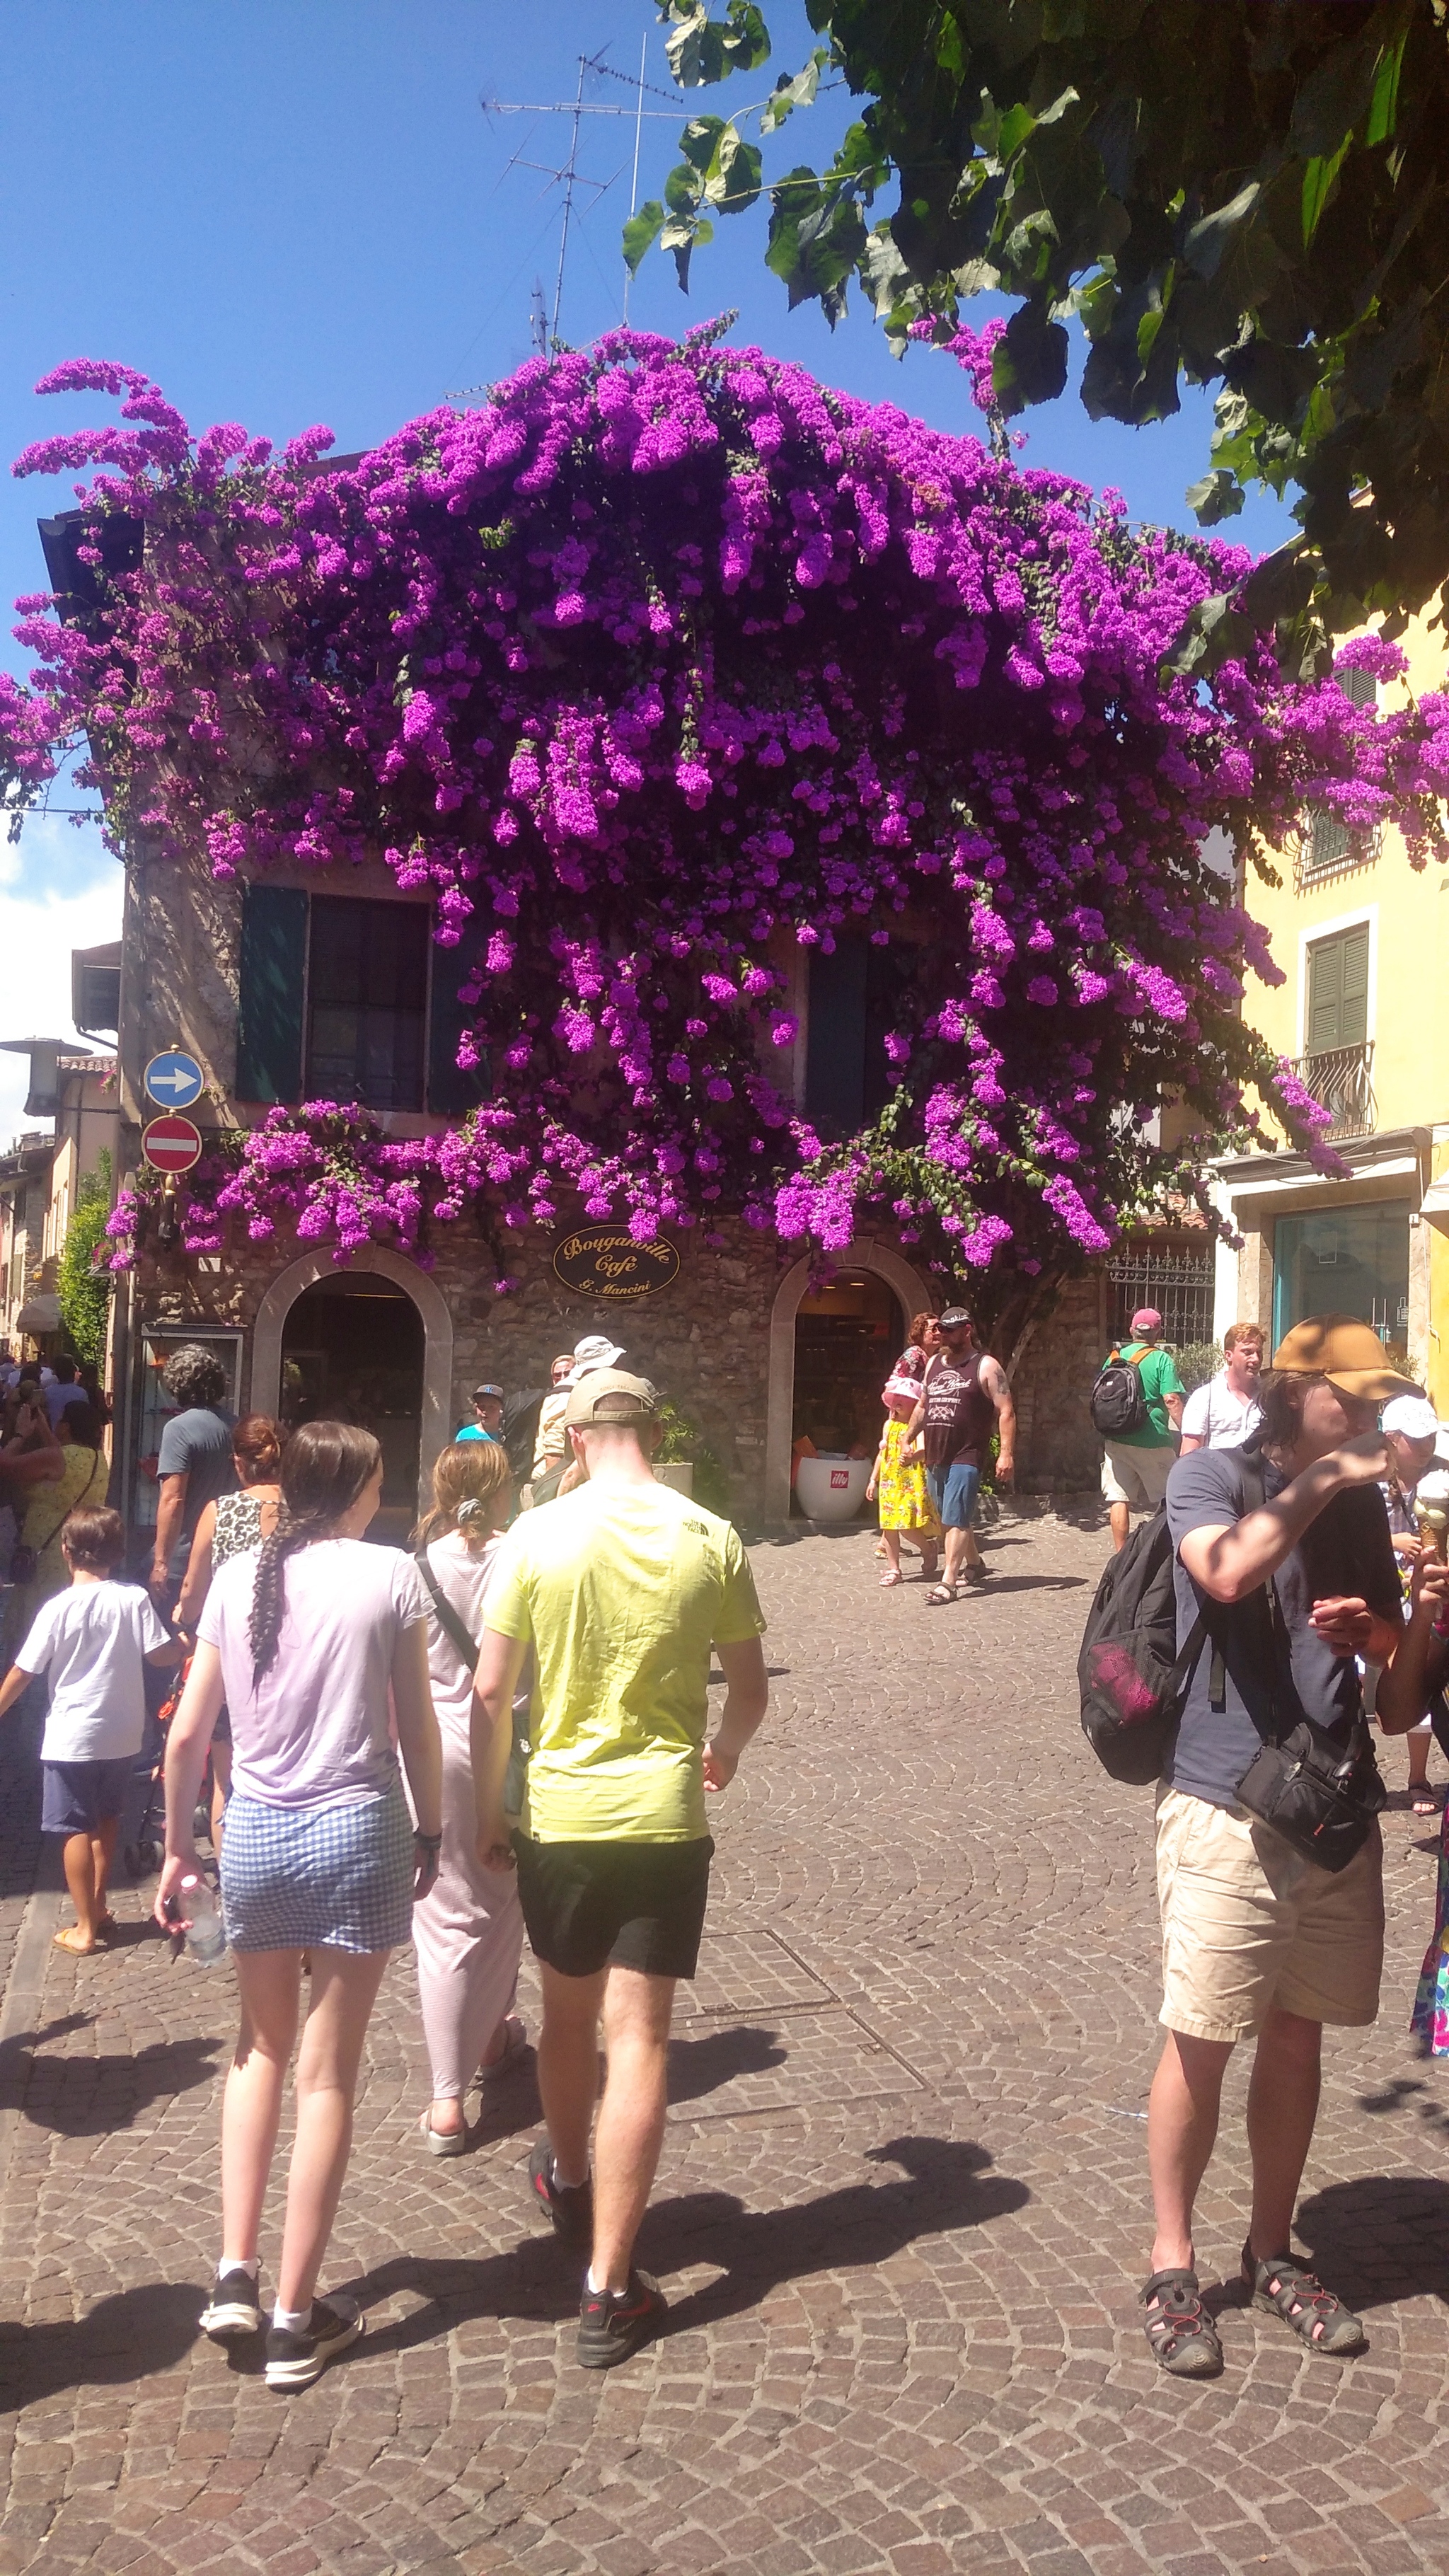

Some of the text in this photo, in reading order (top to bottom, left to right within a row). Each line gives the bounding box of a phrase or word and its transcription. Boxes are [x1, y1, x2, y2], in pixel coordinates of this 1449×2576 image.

[563, 1237, 671, 1264] Bouganville
[579, 1278, 652, 1295] G. Mancini
[832, 1472, 848, 1487] illy
[683, 1521, 700, 1530] NORTH
